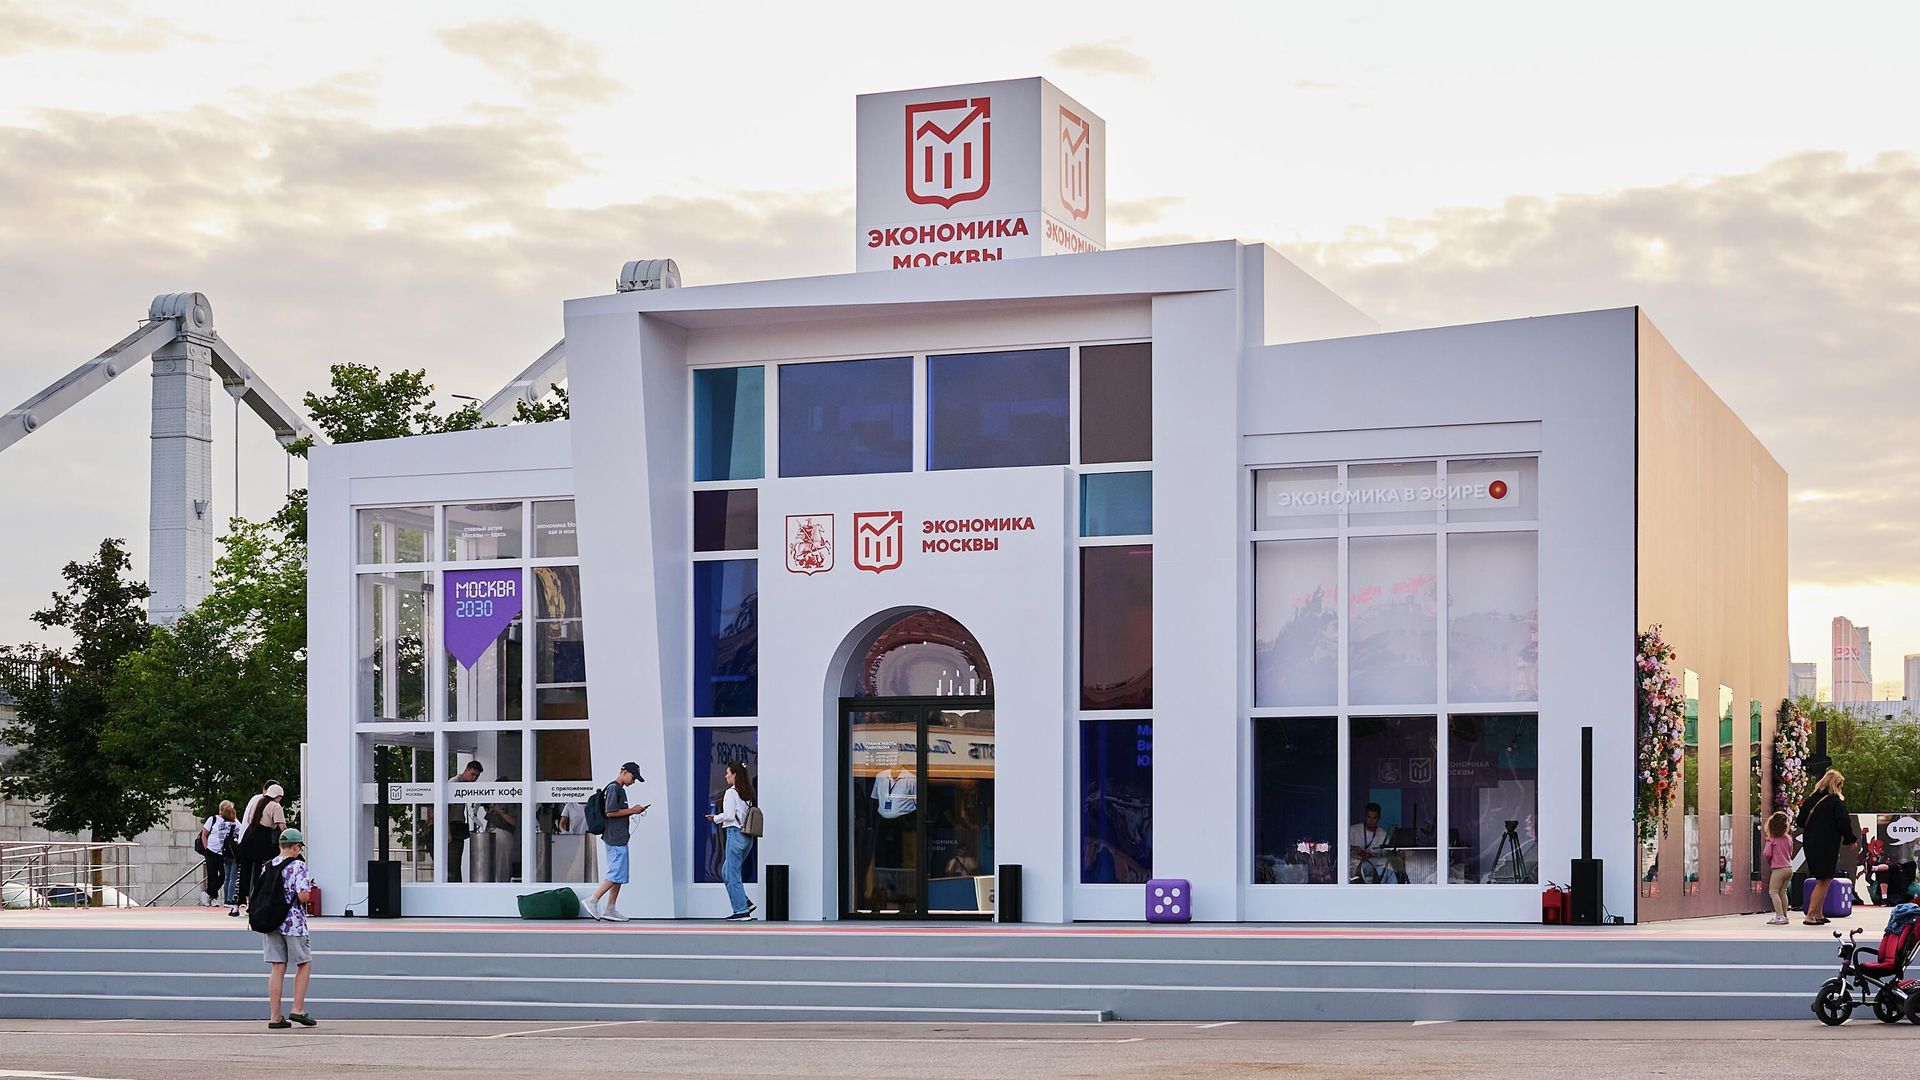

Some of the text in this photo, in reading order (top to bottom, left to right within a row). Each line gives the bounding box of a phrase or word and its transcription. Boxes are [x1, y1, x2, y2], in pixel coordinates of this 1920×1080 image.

[867, 217, 1029, 248] ЭКОНОМИКА
[1045, 219, 1101, 252] ЭКОНОМИ
[892, 247, 1003, 270] МОСКВЫ
[1277, 484, 1485, 507] ЭКОНОМИКА В ЭФИРЕ
[922, 516, 1036, 534] ЭКОНОМИКА
[921, 536, 999, 553] МОСКВЫ
[456, 580, 516, 598] МОСКВА
[456, 600, 493, 618] 2030
[454, 786, 523, 798] дринкит кофе
